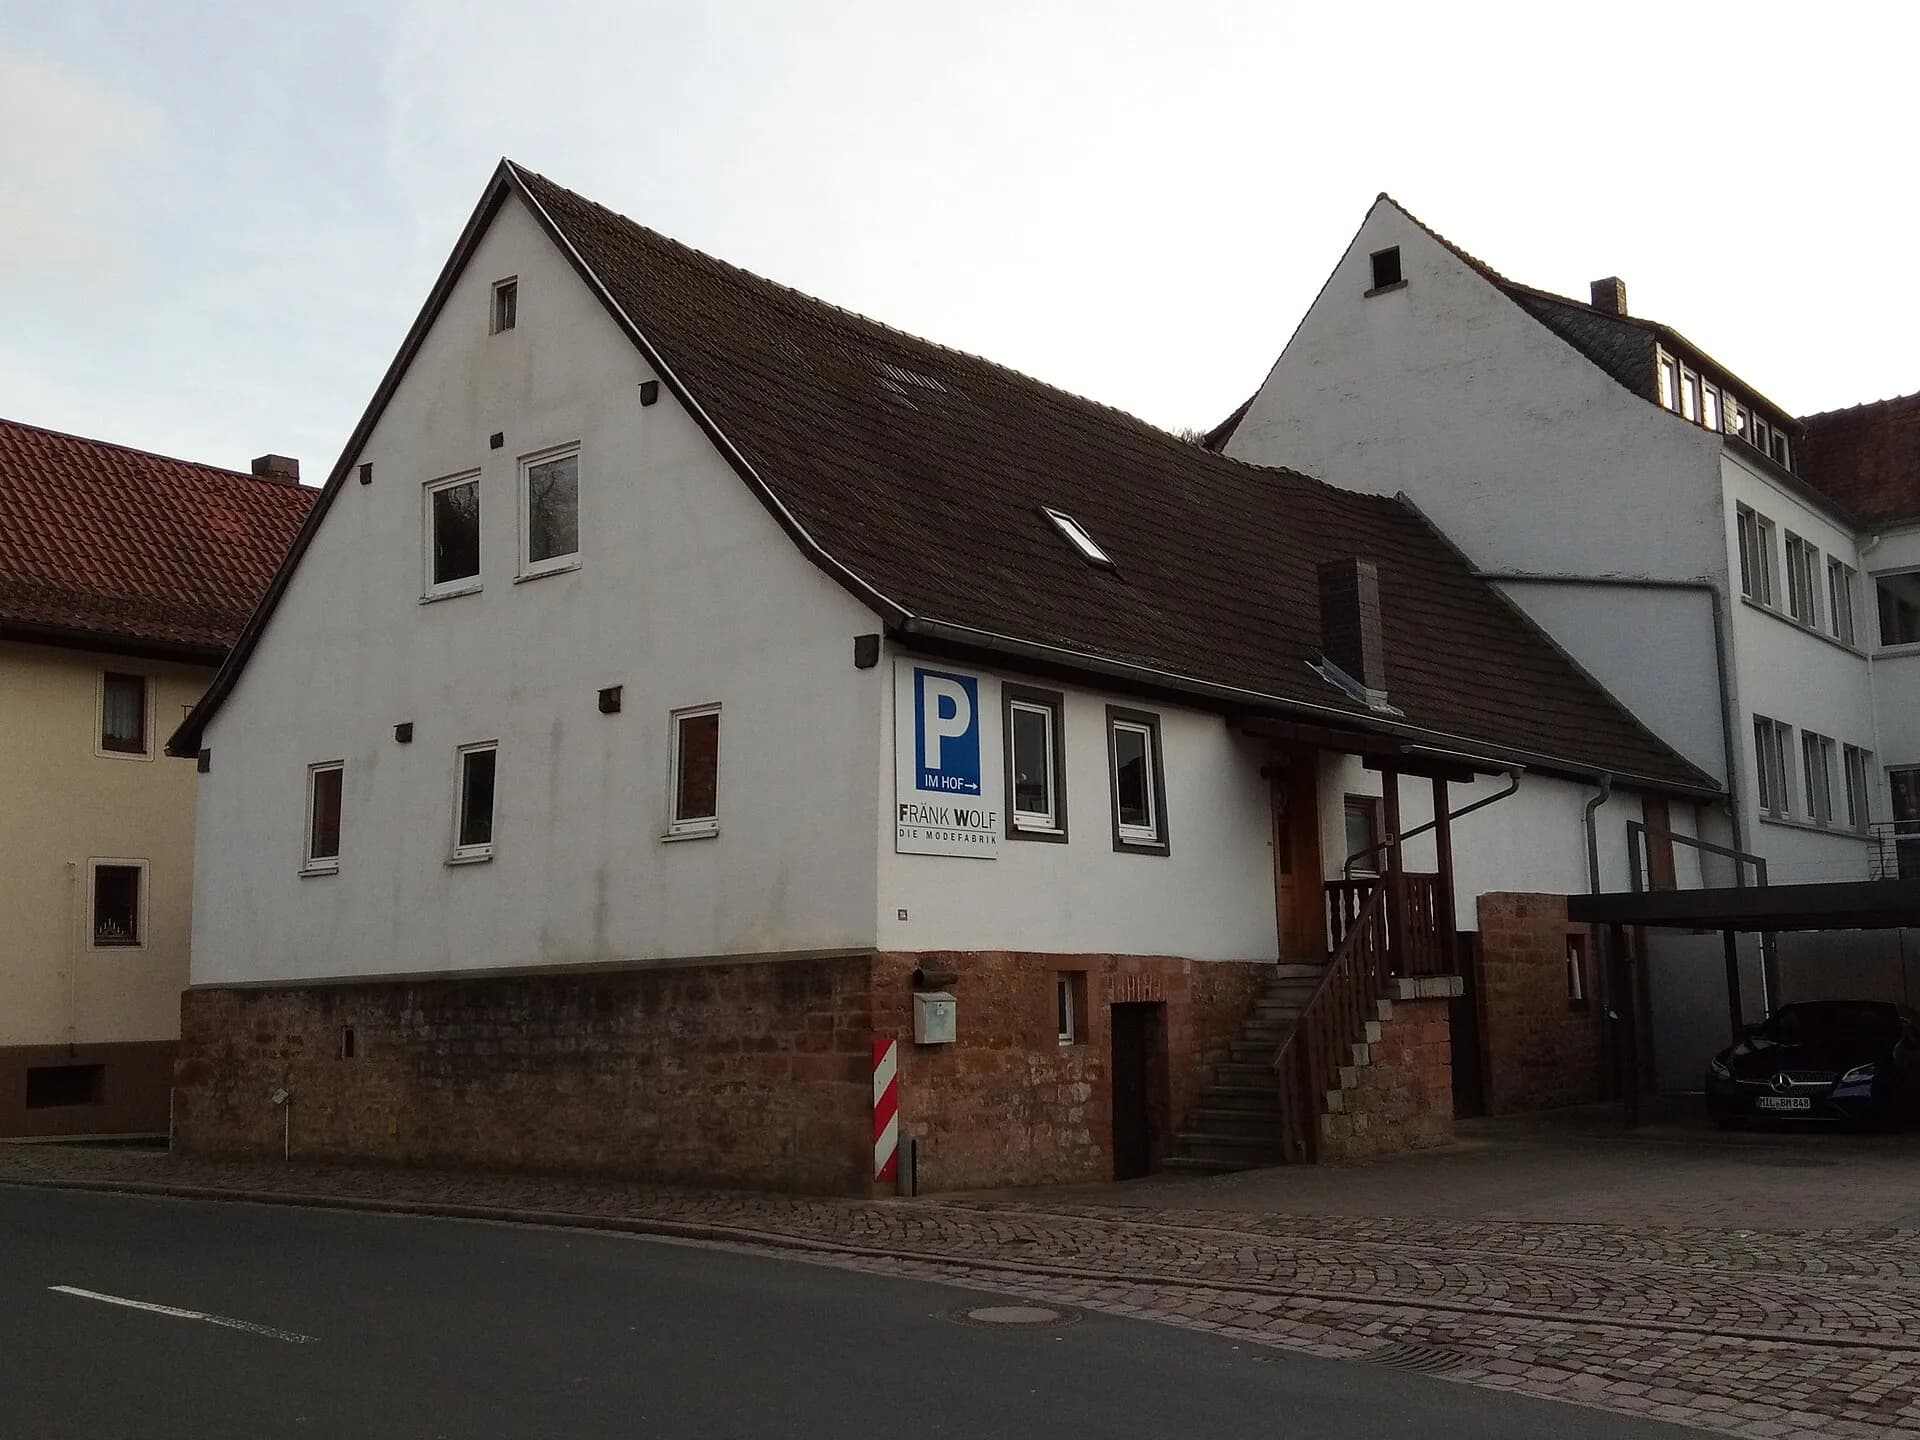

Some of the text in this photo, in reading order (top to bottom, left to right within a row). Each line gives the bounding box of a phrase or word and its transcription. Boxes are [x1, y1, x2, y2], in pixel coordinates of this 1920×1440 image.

[923, 675, 971, 769] P
[925, 774, 964, 790] IM HOF
[899, 802, 997, 829] FRÄNK WOLF
[899, 829, 997, 845] DIE MODEFABRIK
